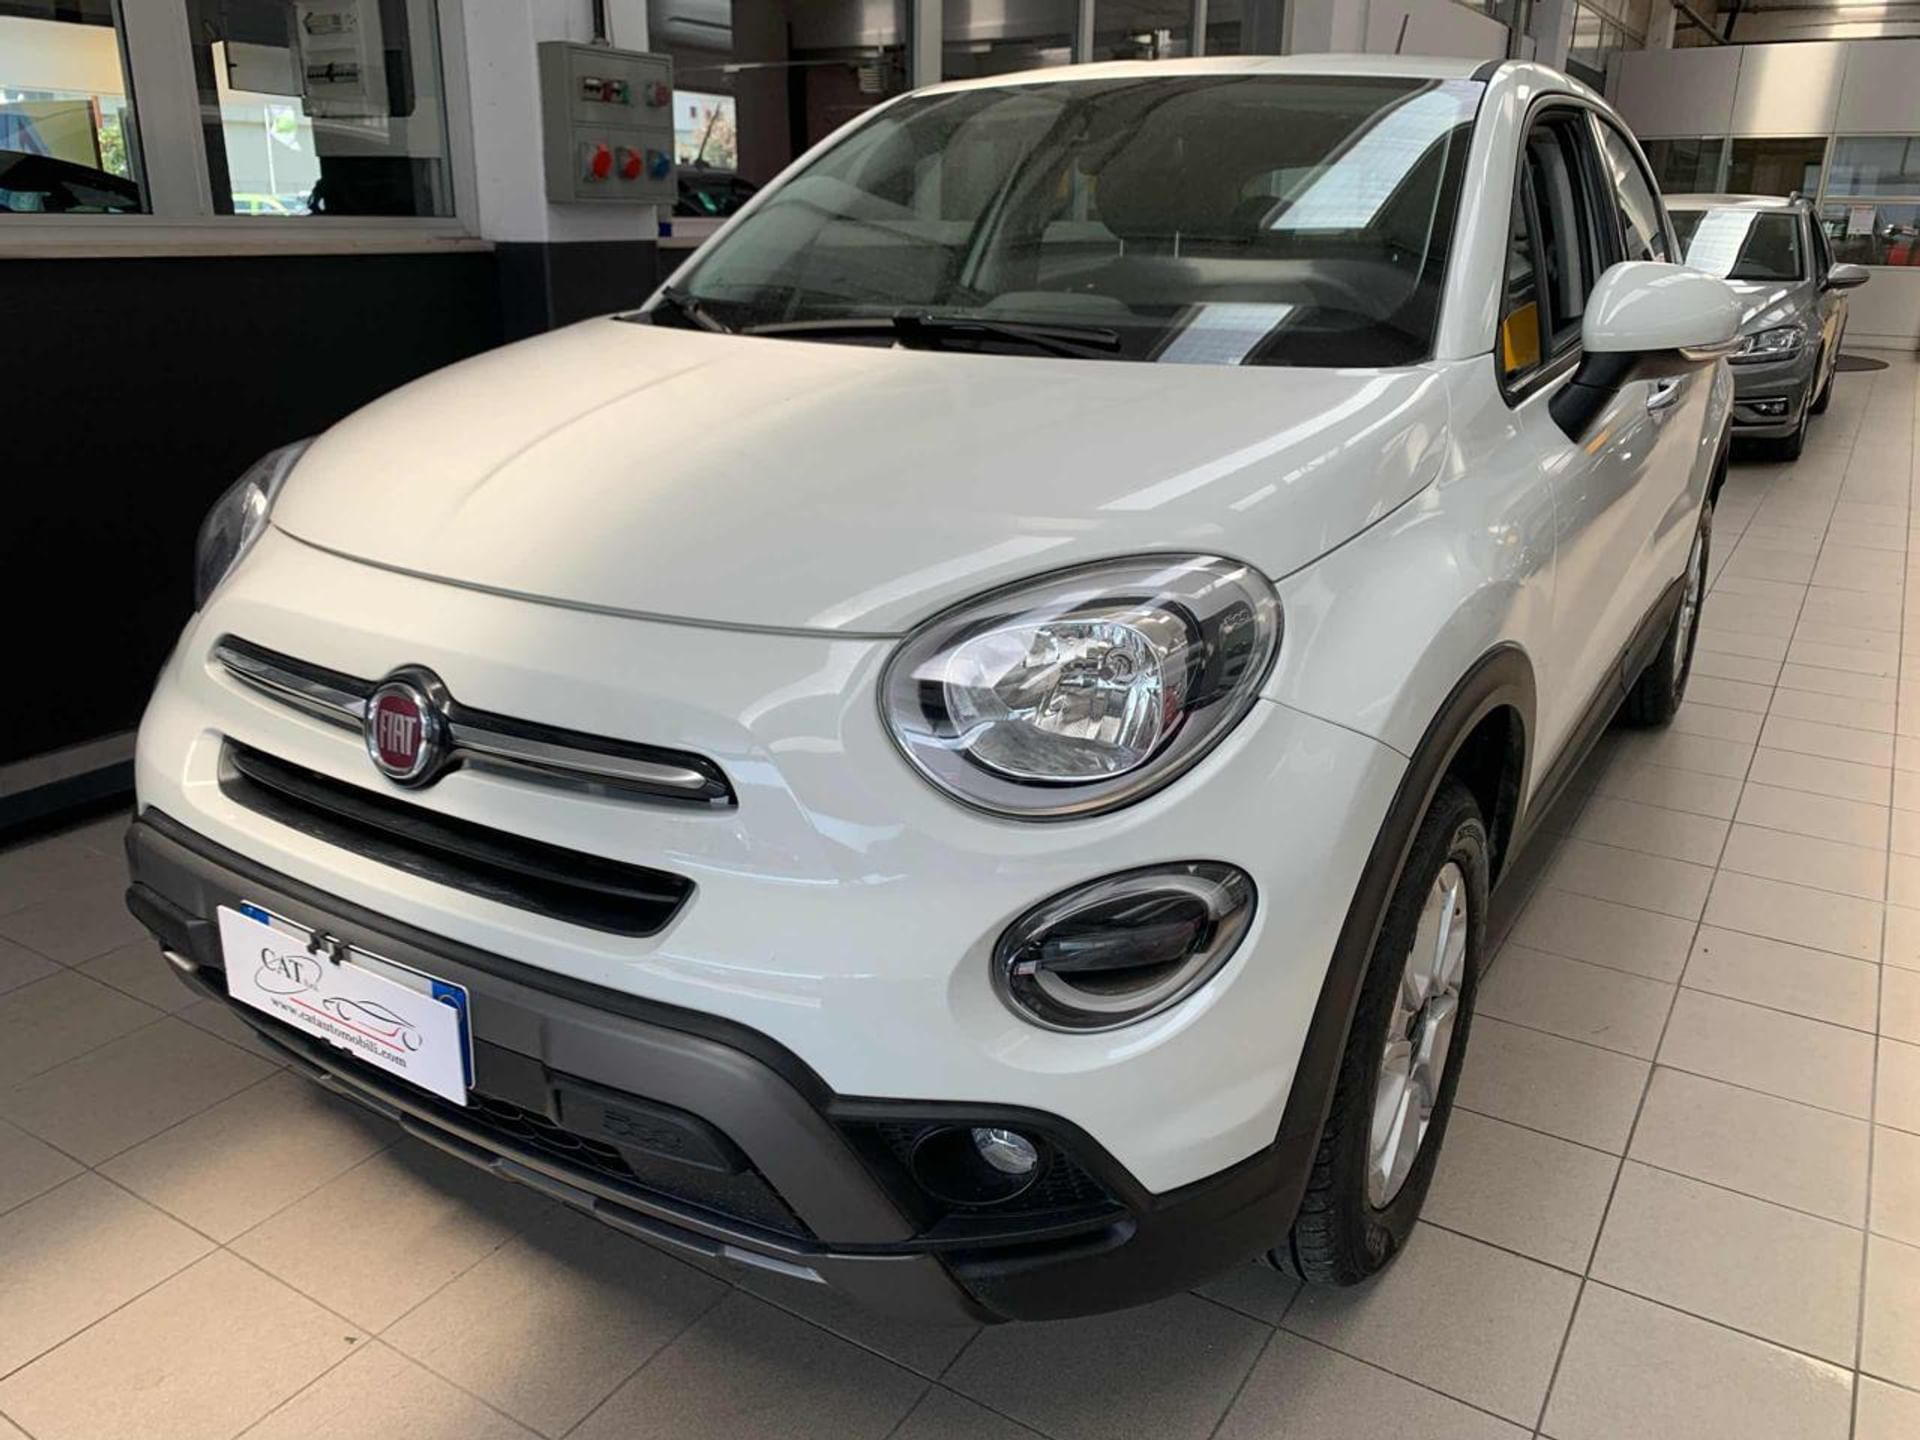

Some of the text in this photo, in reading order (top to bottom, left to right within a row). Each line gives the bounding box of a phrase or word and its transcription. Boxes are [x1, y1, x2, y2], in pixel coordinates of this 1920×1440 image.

[380, 708, 417, 756] FIAT
[261, 947, 304, 984] CAT
[270, 997, 407, 1068] www.catautomobili.com
